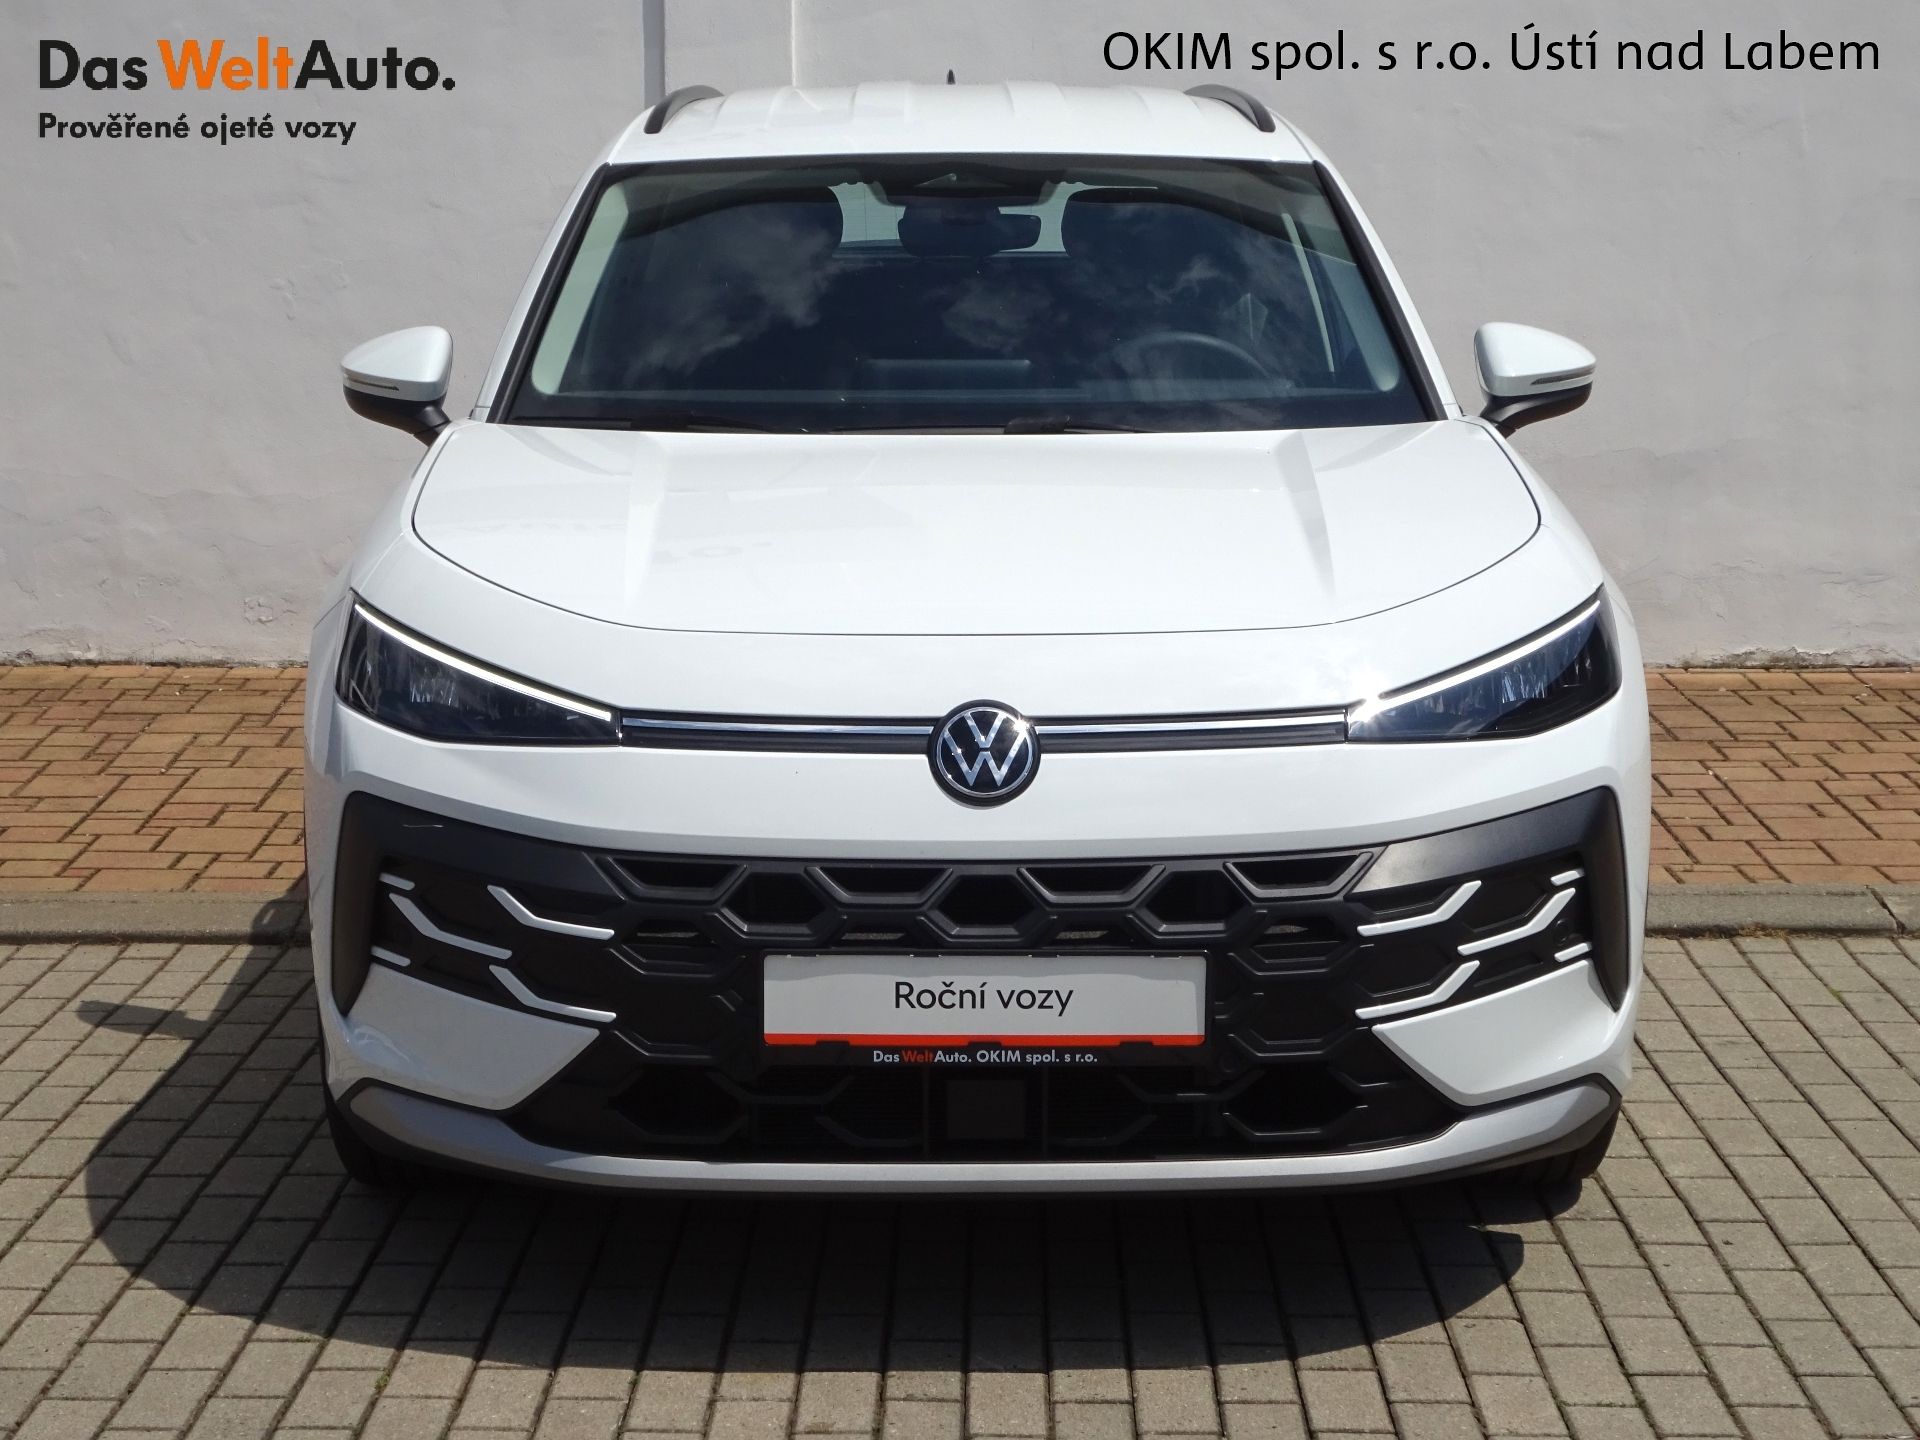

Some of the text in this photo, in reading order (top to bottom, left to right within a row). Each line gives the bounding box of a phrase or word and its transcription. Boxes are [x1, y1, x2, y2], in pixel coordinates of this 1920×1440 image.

[894, 981, 1074, 1017] Roční vozy
[873, 1050, 900, 1063] Das
[976, 1050, 1021, 1063] OKIM
[1025, 1049, 1060, 1066] spol.
[1064, 1053, 1071, 1063] s
[1075, 1053, 1098, 1063] r.o.
